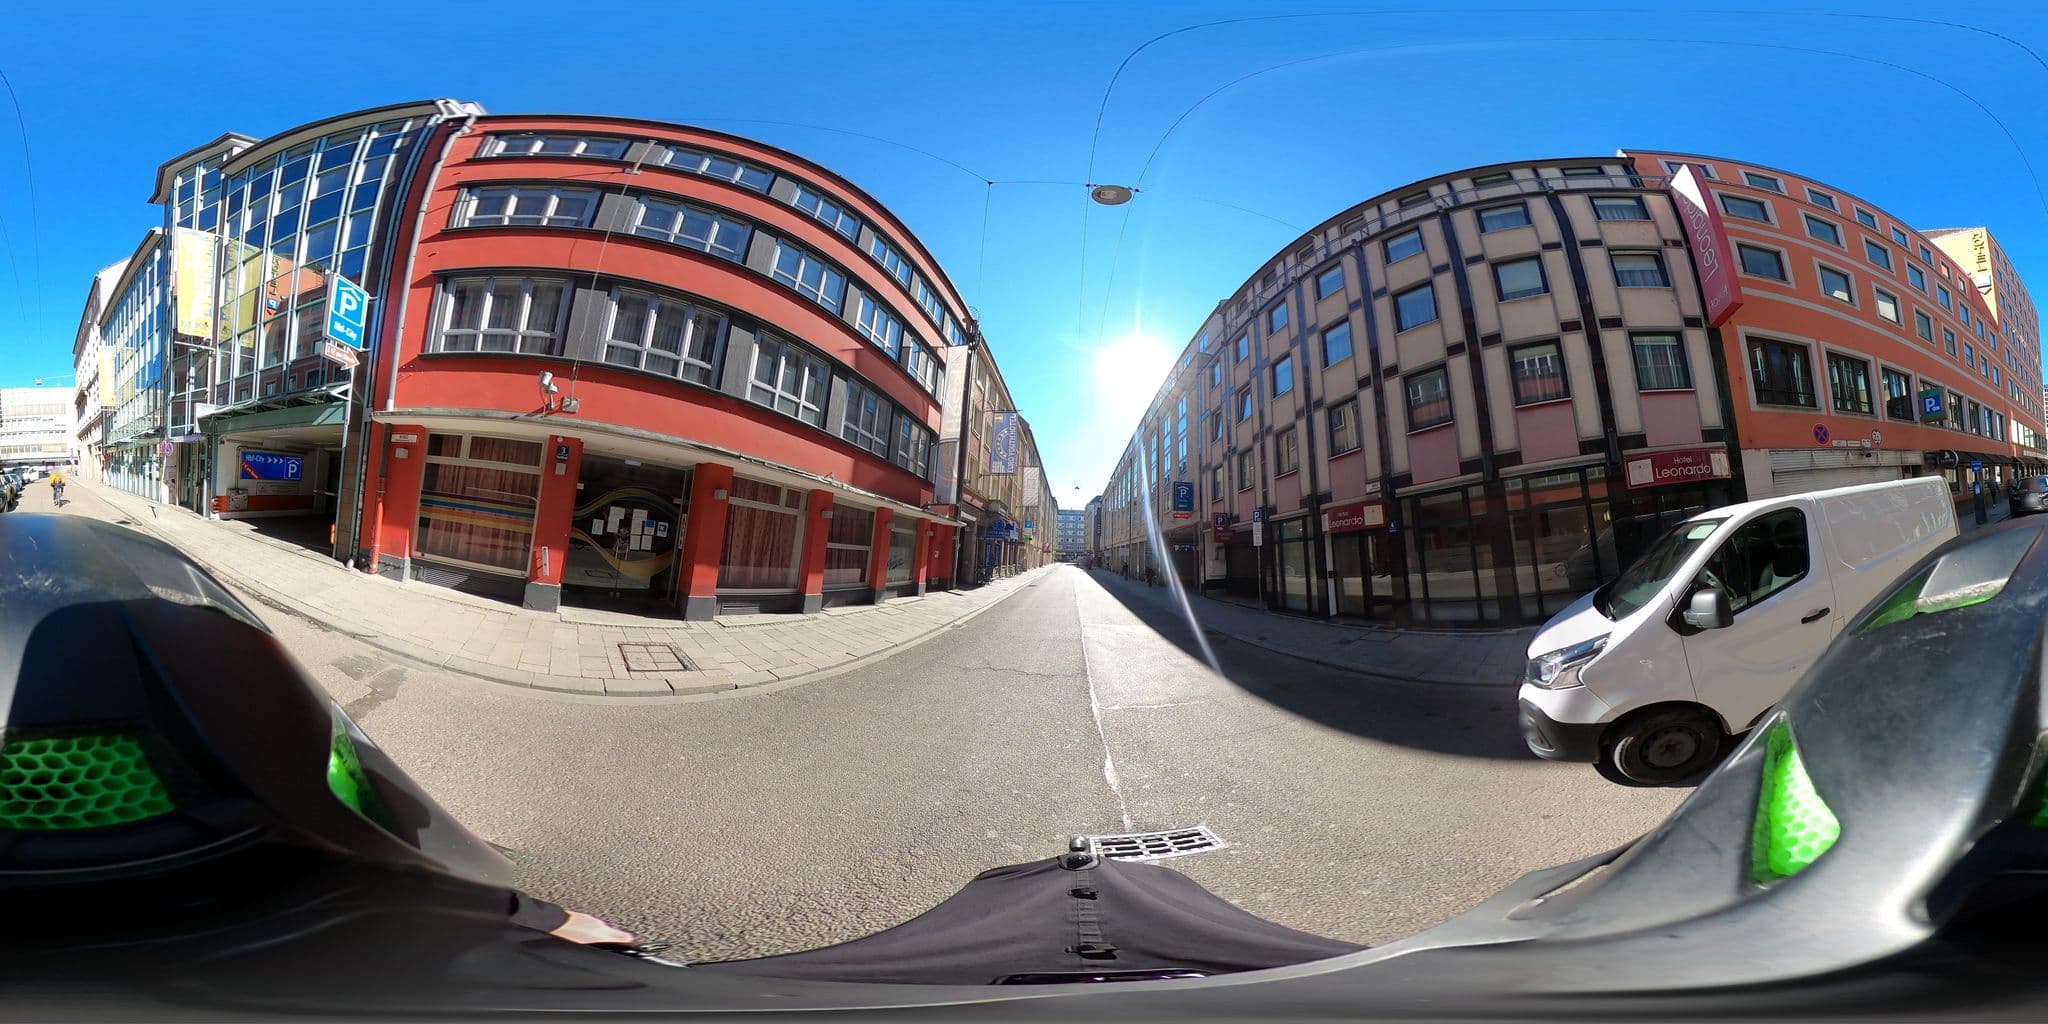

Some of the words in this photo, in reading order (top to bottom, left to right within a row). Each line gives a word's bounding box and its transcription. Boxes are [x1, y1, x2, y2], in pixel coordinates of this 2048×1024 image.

[339, 291, 358, 316] P
[1673, 456, 1693, 465] Hotel
[288, 463, 298, 478] P
[1655, 463, 1711, 479] Leonardo
[1254, 511, 1260, 521] P
[1329, 515, 1364, 528] Leonardo
